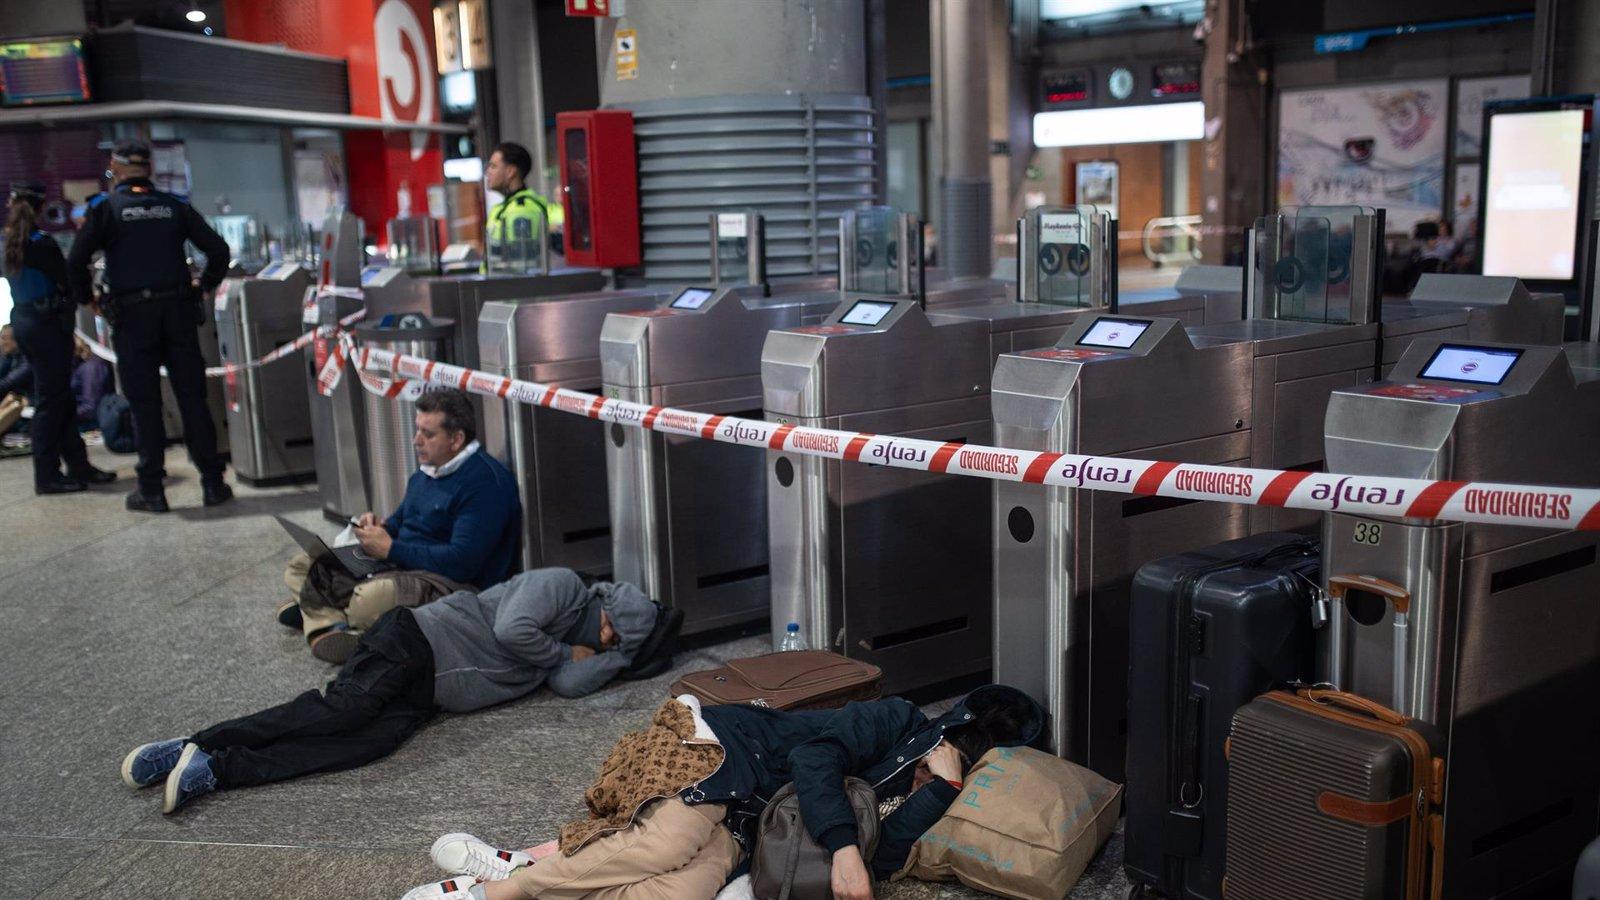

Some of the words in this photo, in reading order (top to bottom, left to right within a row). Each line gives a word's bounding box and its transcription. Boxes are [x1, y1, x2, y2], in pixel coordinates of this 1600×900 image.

[512, 383, 541, 403] renfe
[606, 403, 641, 423] renfe
[724, 421, 766, 443] renfe
[792, 430, 838, 453] SEGURIDAD
[873, 440, 925, 465] renfe
[959, 450, 1018, 475] SEGURIDAD
[1062, 457, 1131, 487] renfe
[1175, 469, 1252, 497] SEGURIDAD
[1311, 476, 1405, 510] renfe
[1465, 489, 1571, 520] SEGURIDAD
[1355, 523, 1380, 545] 38
